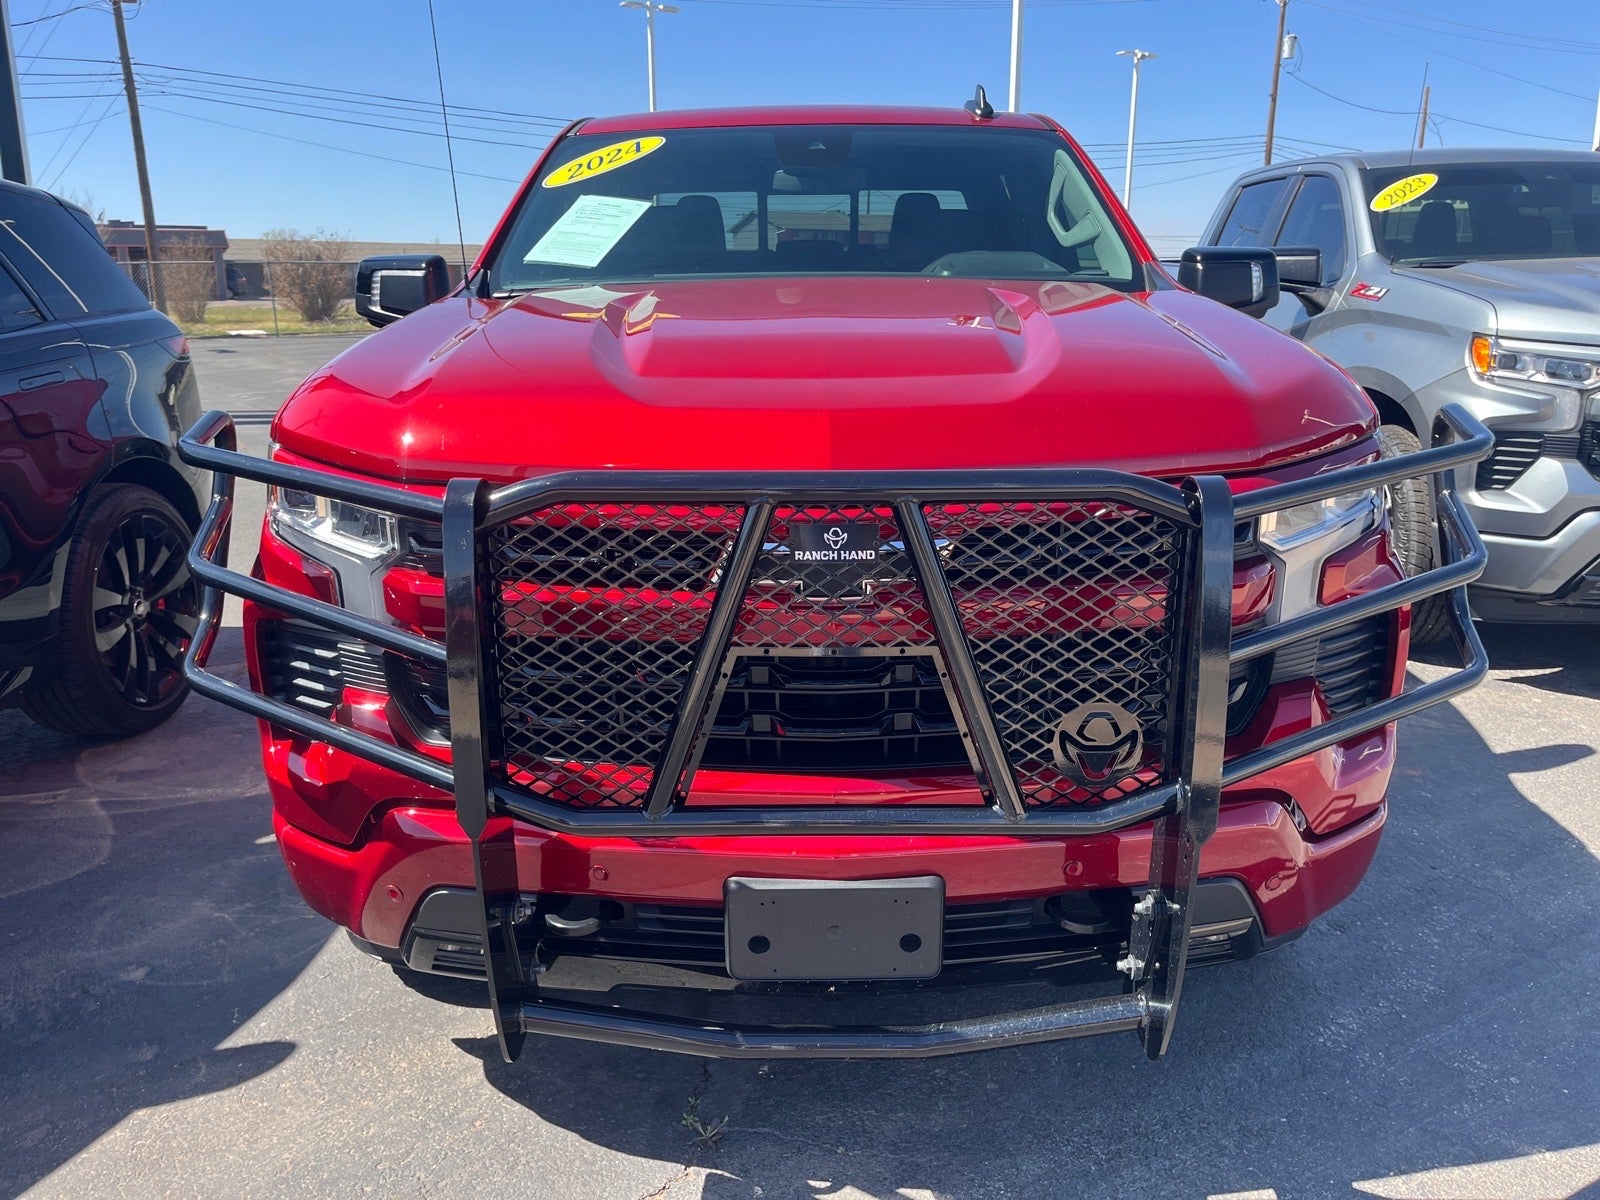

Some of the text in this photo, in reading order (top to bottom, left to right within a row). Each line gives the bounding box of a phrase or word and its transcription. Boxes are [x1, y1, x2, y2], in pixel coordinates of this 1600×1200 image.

[567, 140, 645, 180] 2024
[1383, 177, 1427, 206] 2023
[795, 550, 875, 560] RANCH HAND
